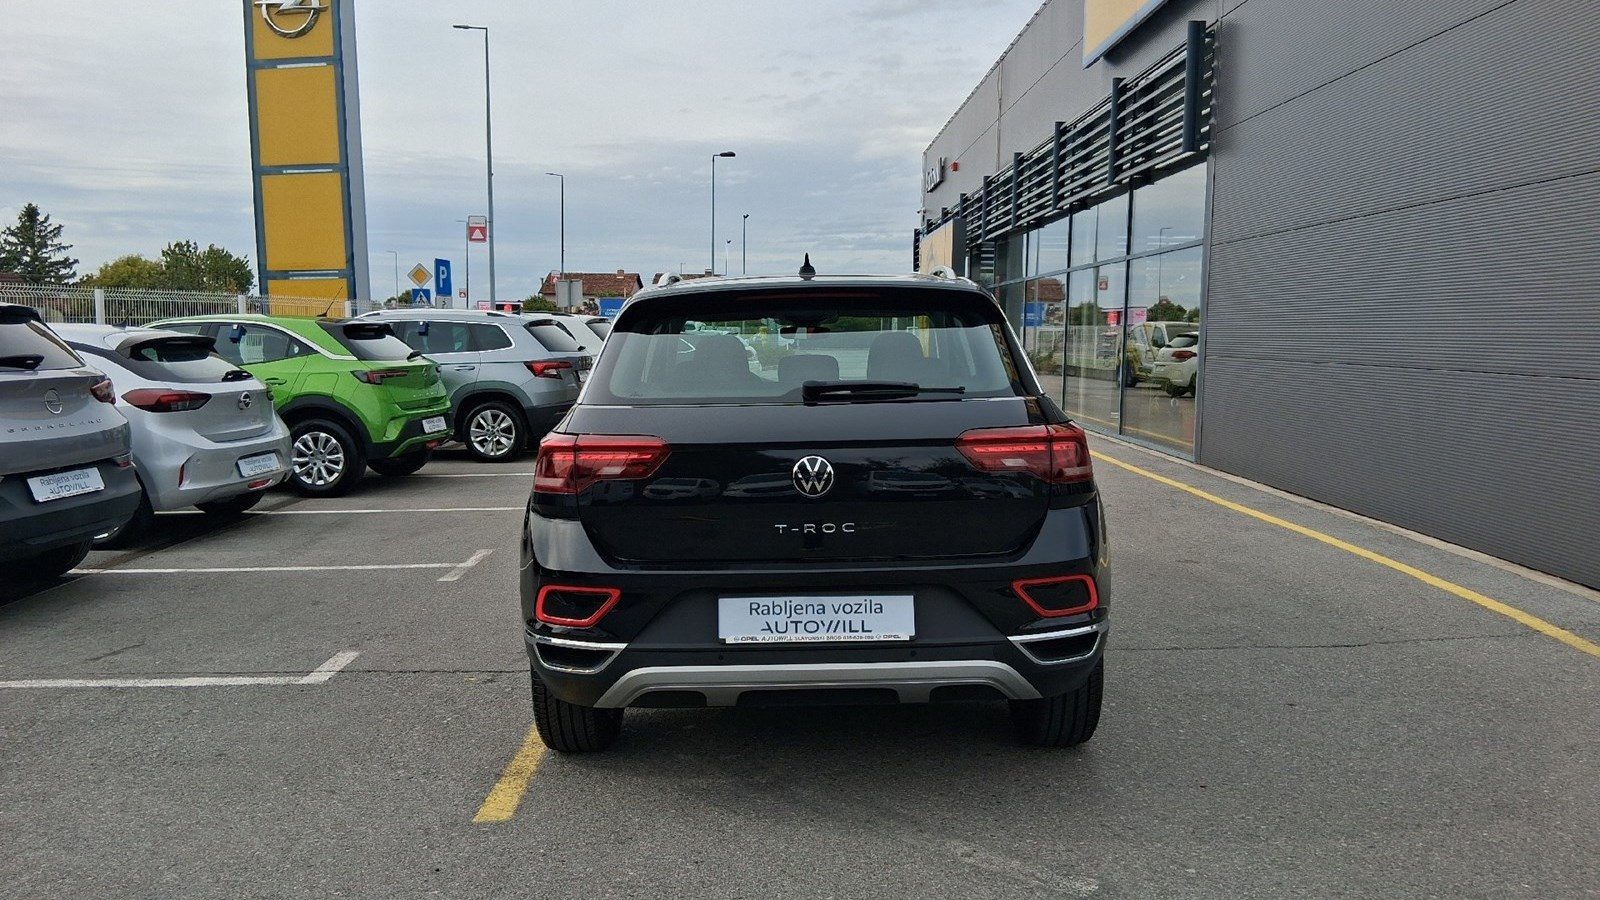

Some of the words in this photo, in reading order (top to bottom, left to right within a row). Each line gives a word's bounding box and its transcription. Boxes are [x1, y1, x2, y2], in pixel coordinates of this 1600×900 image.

[439, 265, 448, 288] P
[775, 523, 855, 534] T-ROC
[749, 600, 826, 618] Rabljena
[831, 599, 884, 615] vozila
[760, 620, 873, 634] AUTOWILL
